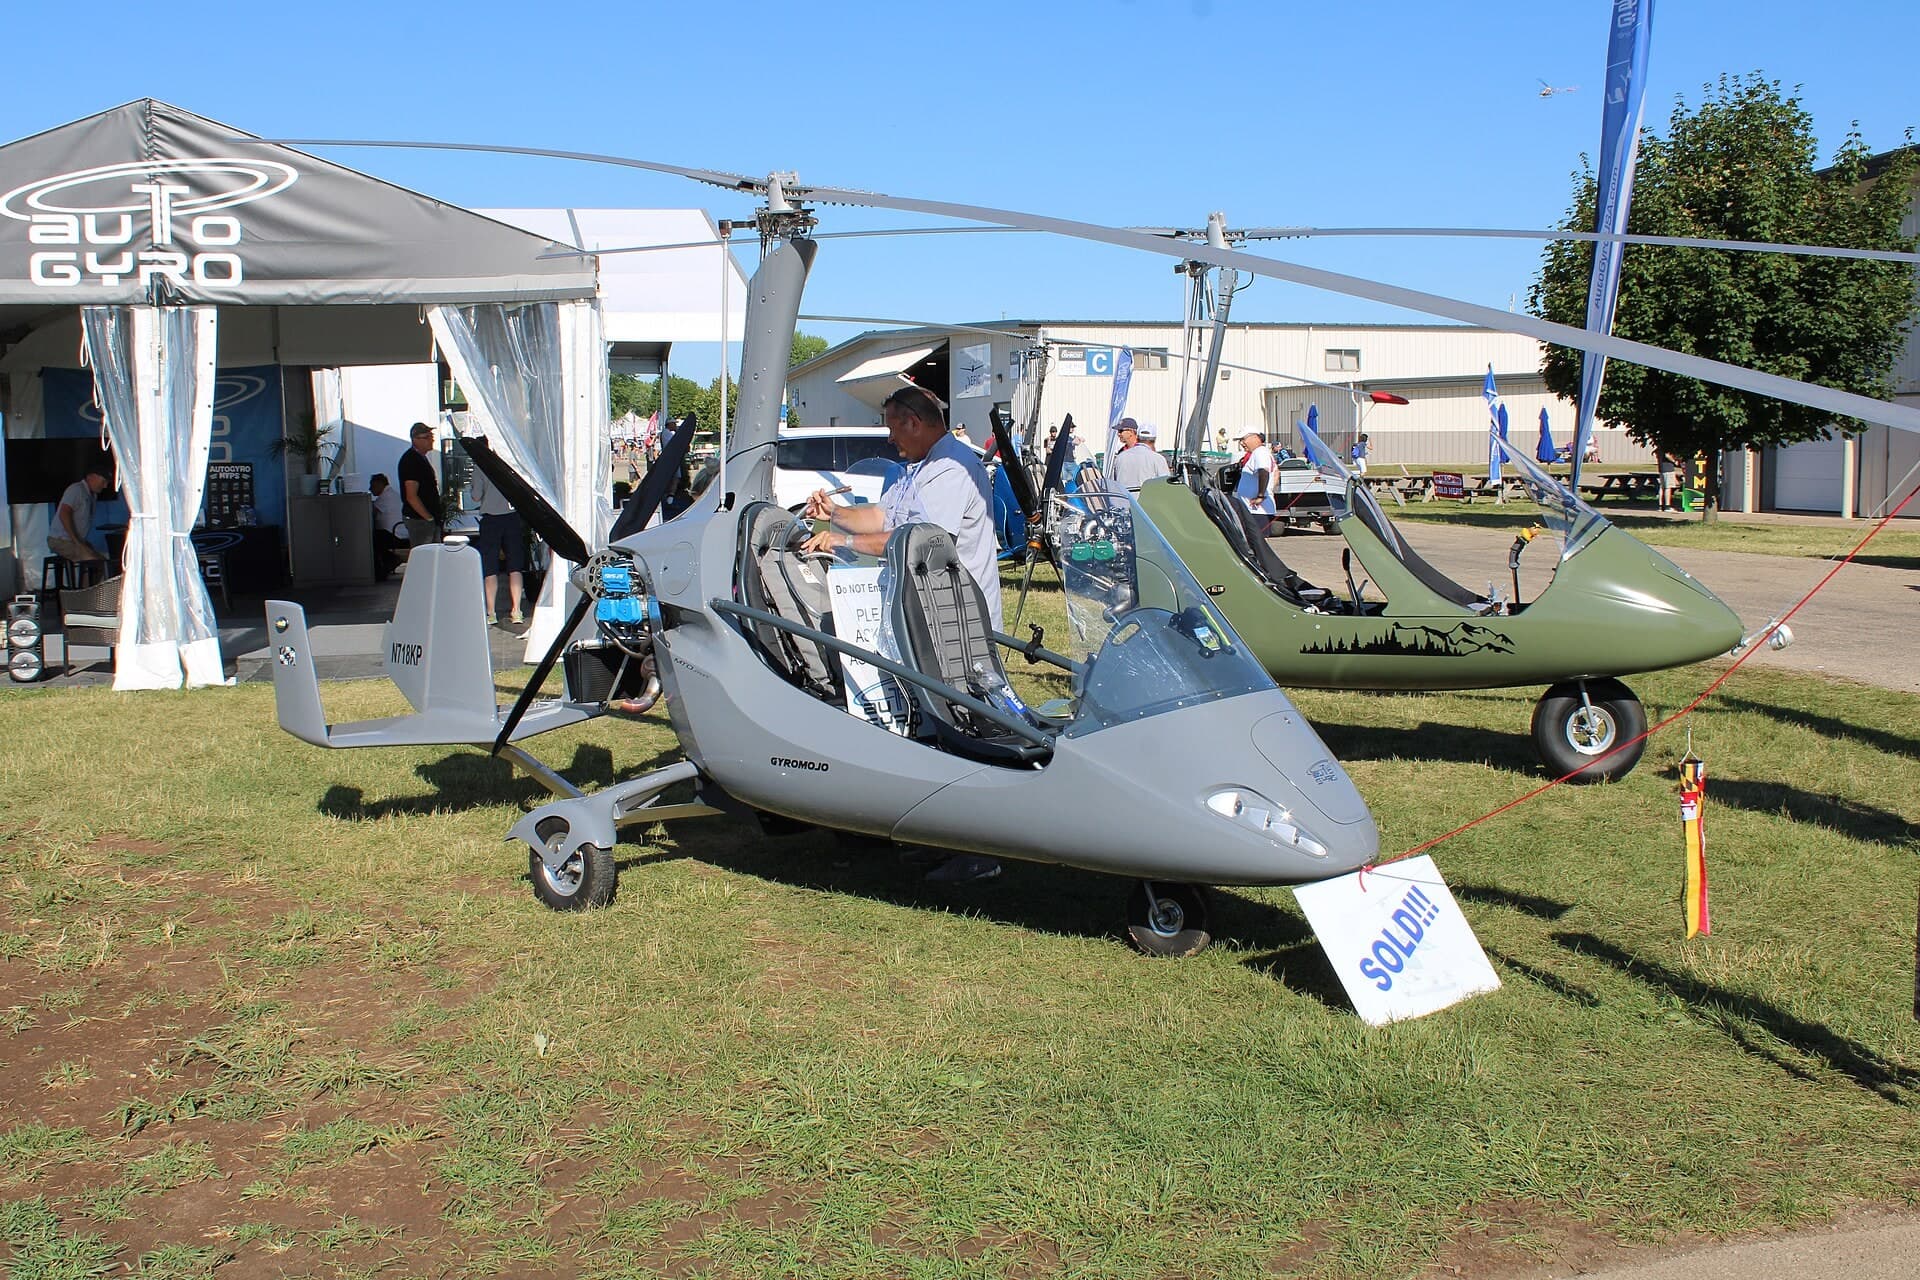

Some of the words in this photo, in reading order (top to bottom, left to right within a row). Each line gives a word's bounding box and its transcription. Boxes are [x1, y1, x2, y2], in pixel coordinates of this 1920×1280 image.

[30, 252, 243, 287] GYRO
[1092, 353, 1108, 373] C
[210, 465, 251, 473] AUTOGYRO
[836, 584, 847, 594] Do
[849, 584, 865, 593] NOT
[391, 642, 422, 666] N718KP
[770, 756, 829, 772] GYROMOJO
[1359, 884, 1440, 992] SOLD!!!
